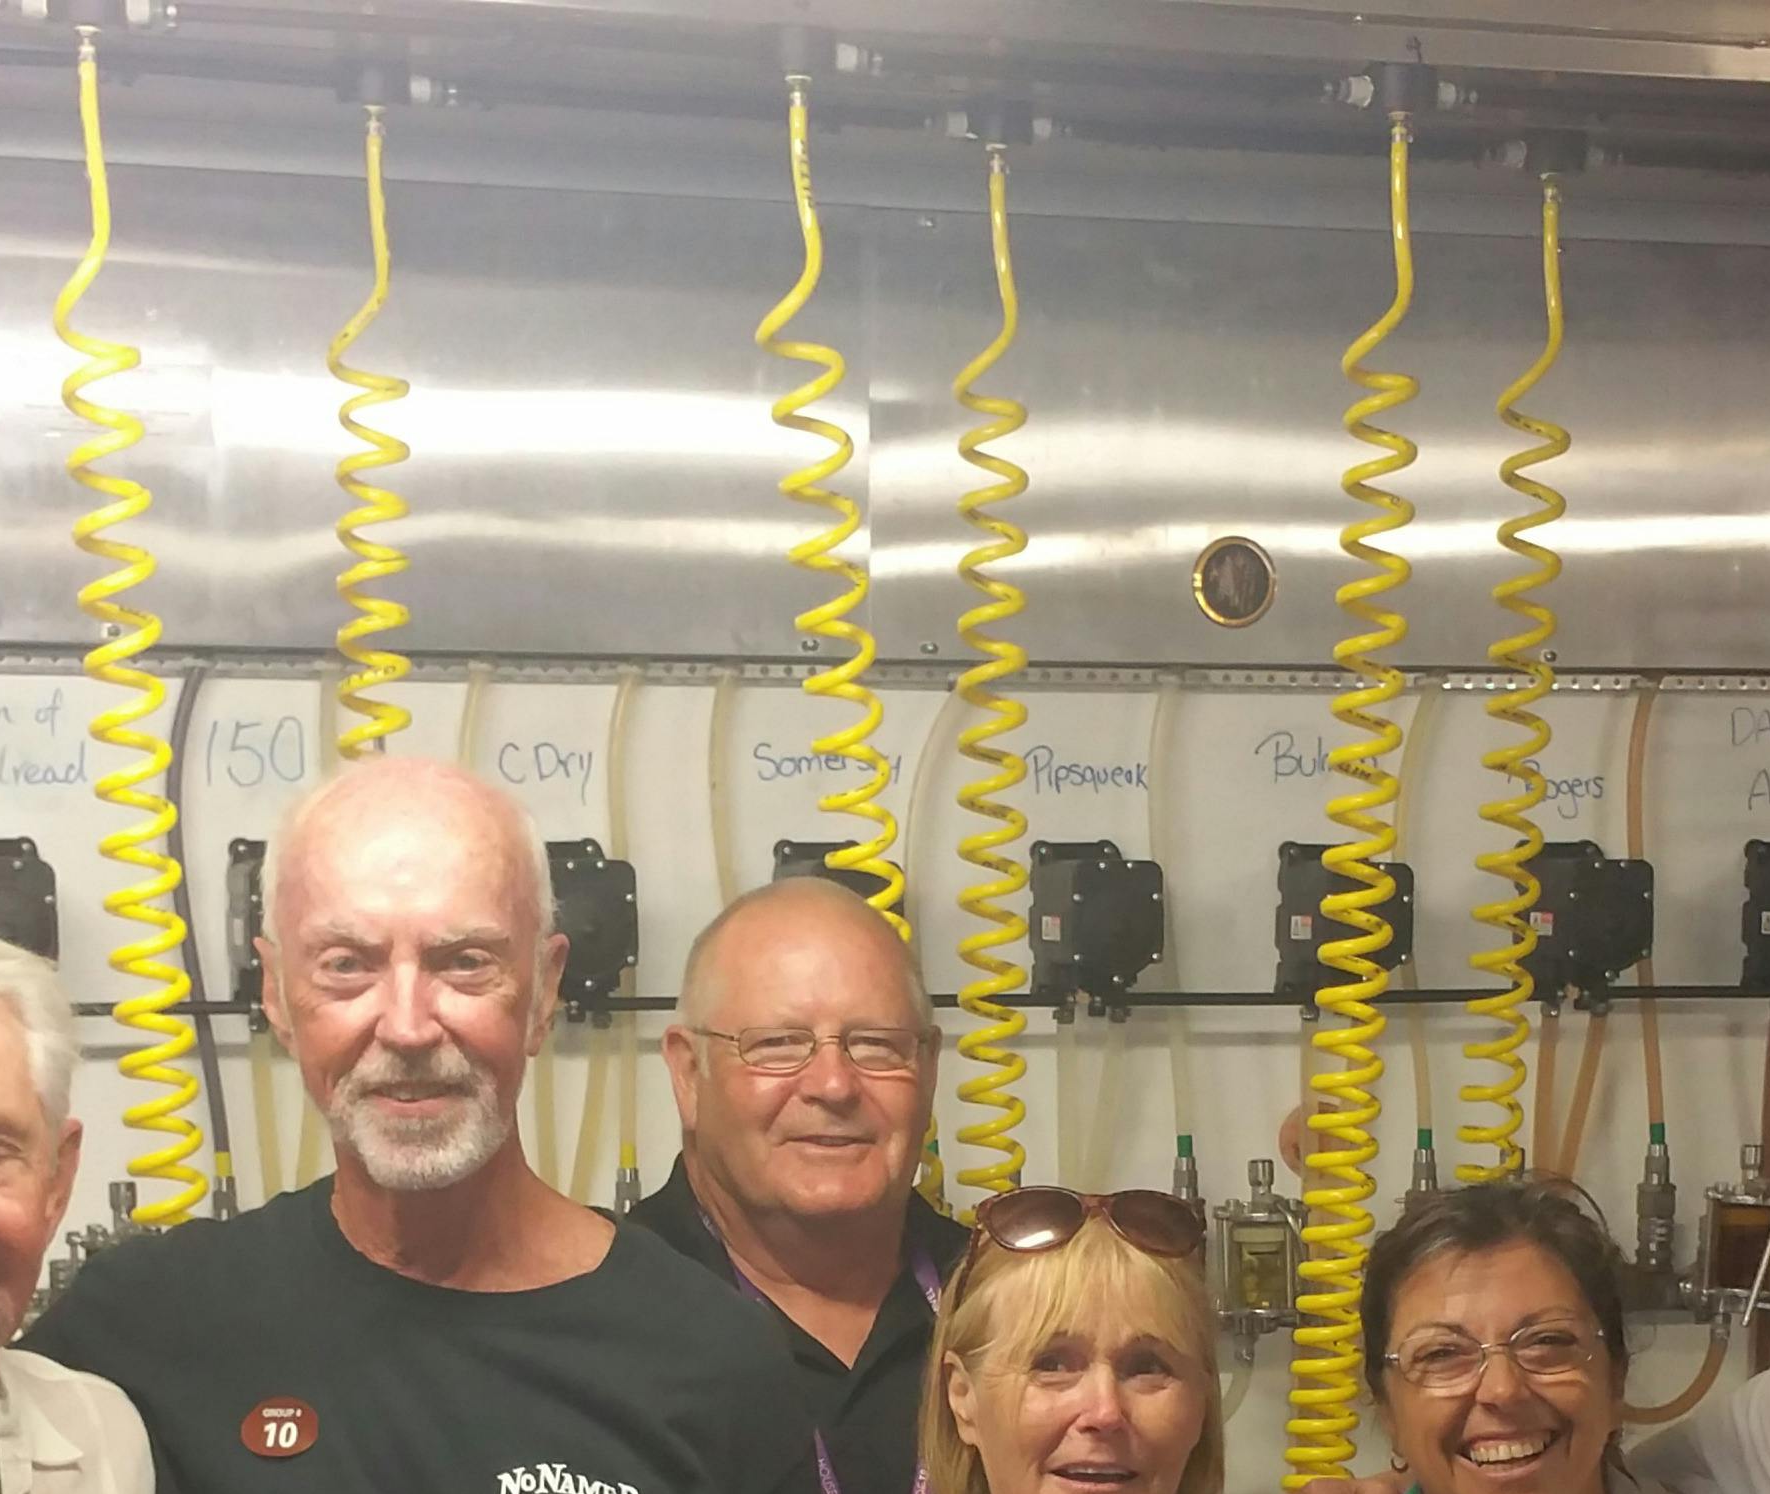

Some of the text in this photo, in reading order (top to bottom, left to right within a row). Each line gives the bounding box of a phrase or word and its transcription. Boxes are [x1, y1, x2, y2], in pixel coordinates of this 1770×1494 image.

[35, 687, 63, 737] of
[206, 715, 306, 788] 150
[263, 1421, 299, 1449] 10
